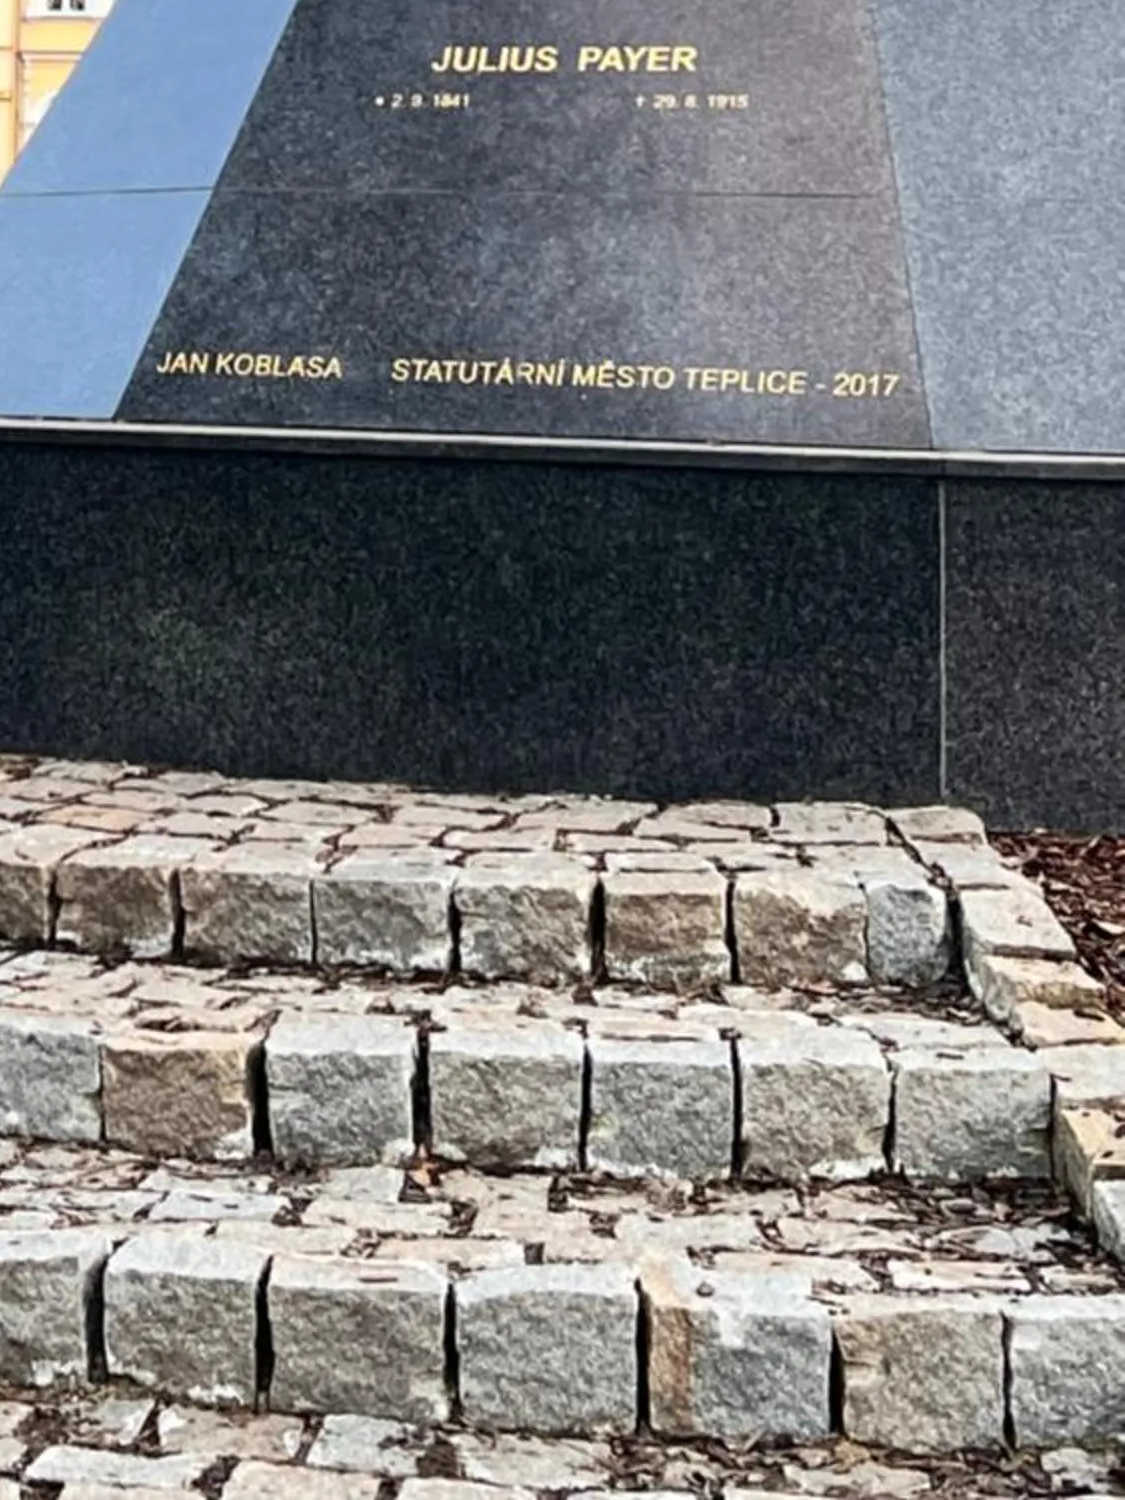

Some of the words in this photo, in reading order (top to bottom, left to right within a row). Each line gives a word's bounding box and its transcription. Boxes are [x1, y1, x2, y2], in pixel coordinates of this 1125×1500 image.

[431, 45, 558, 73] JULIUS
[578, 45, 698, 72] PAYER
[156, 352, 210, 375] JAN
[215, 353, 343, 379] KOBLASA
[391, 357, 566, 387] STATUTÁRNÍ
[572, 359, 676, 390] MĚSTO
[684, 367, 808, 395] TEPLICE
[832, 371, 900, 397] 2017
